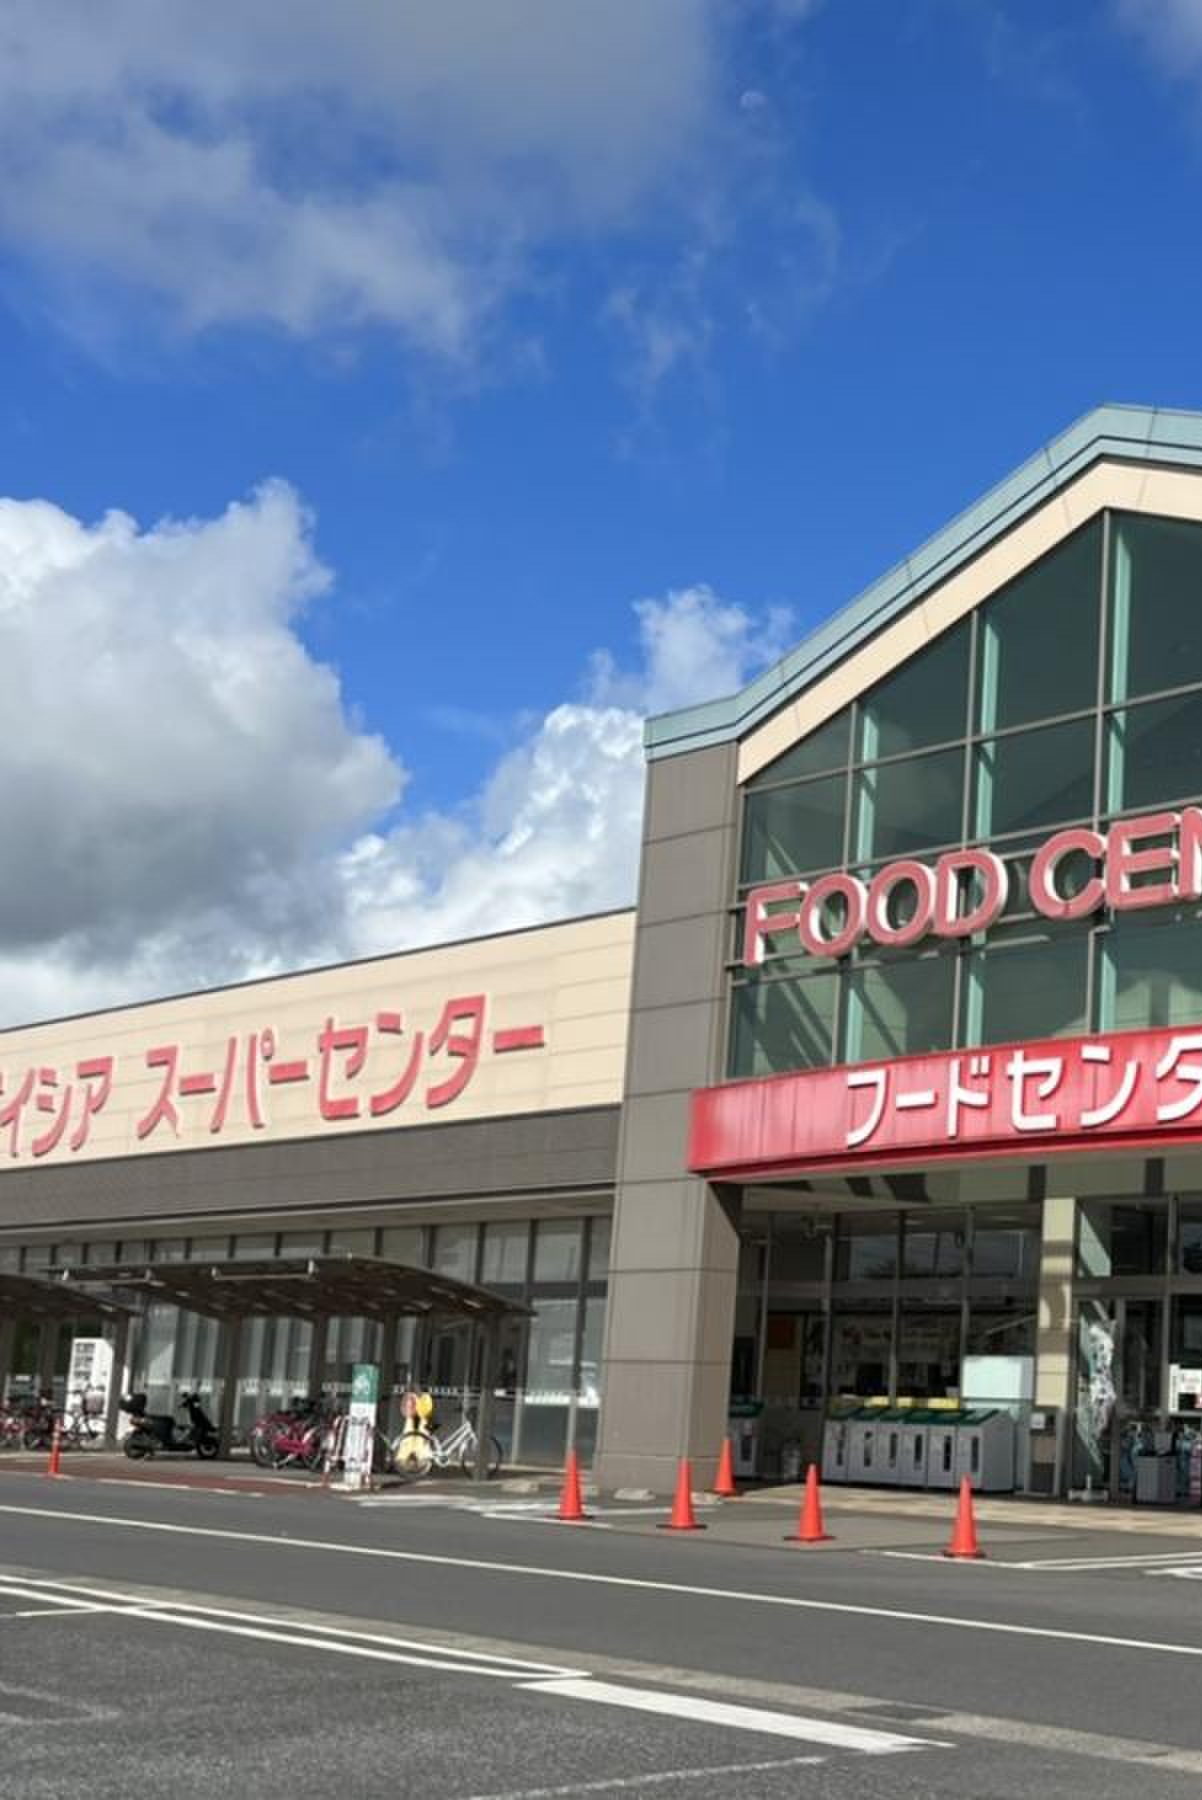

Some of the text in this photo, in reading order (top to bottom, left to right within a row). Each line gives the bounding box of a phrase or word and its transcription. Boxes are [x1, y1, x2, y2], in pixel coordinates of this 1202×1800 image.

[742, 847, 1007, 967] FOOD
[0, 993, 545, 1158] イシア スーパーセンター
